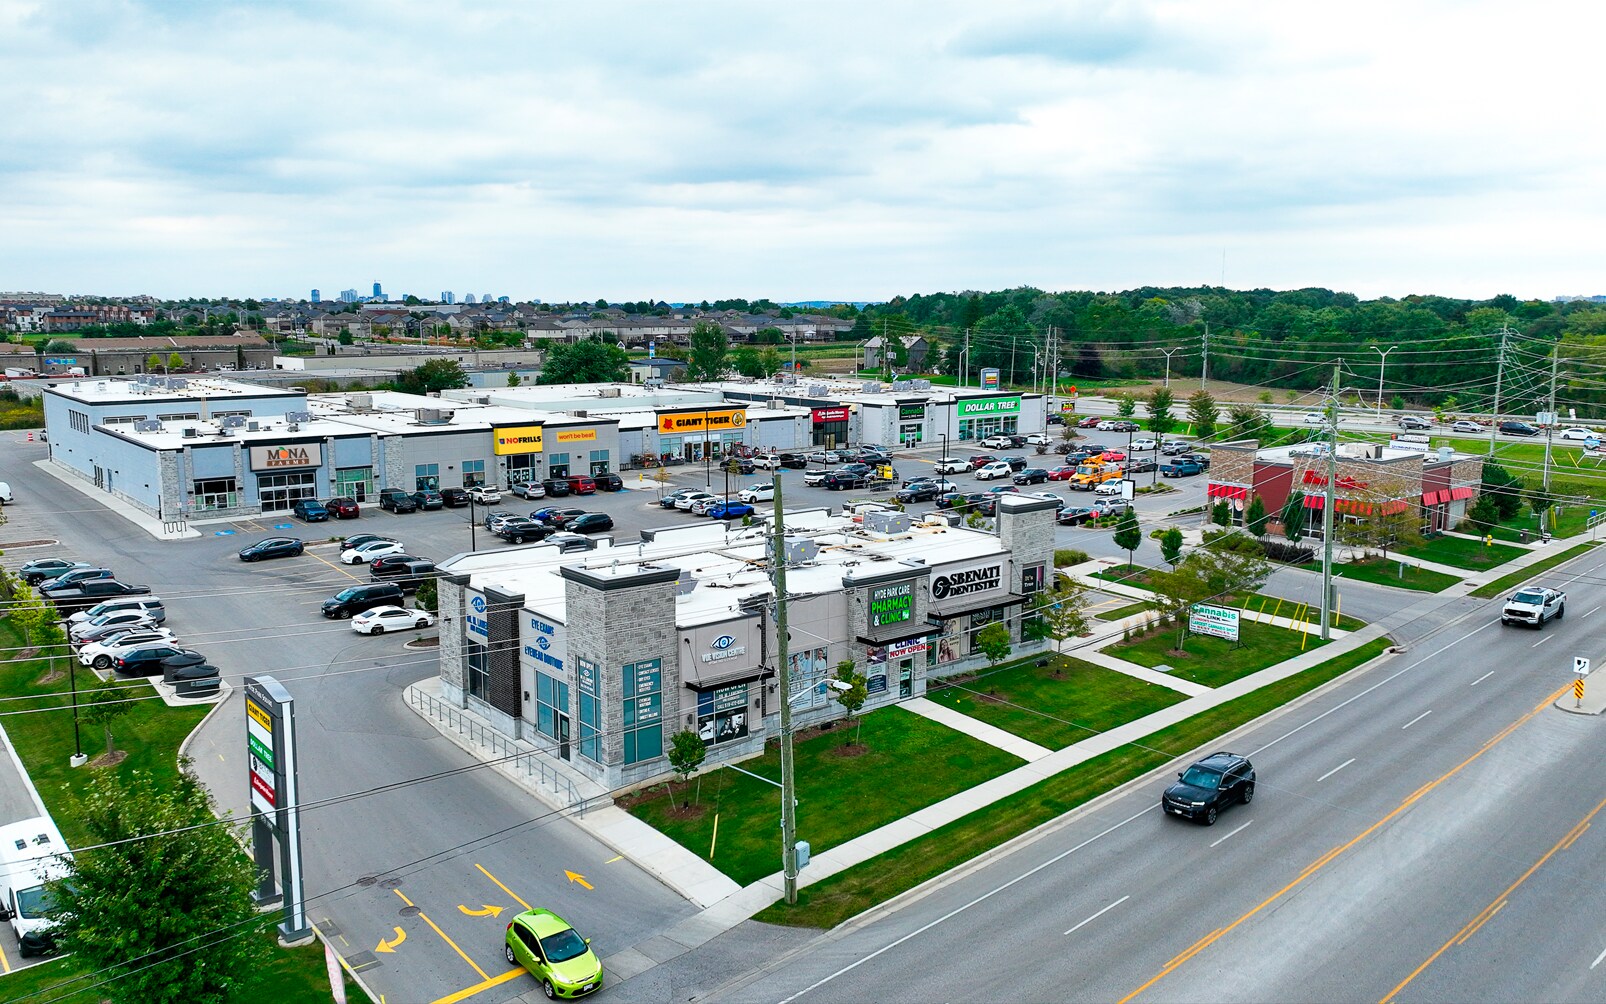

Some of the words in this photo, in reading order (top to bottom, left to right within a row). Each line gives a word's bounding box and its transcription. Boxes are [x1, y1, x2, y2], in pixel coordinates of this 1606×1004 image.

[901, 407, 924, 415] Cannabis
[965, 403, 995, 412] DOLLAR
[997, 401, 1016, 410] TREE
[676, 418, 703, 427] GIANT
[705, 416, 730, 425] TIGER
[949, 564, 1001, 586] SBENATI
[874, 589, 887, 600] HYDE
[887, 586, 898, 597] PARK
[898, 584, 910, 595] CARE
[949, 579, 1000, 597] DENTISTRY
[871, 594, 913, 615] PHARMACY
[1191, 603, 1237, 620] Cannabis
[873, 615, 880, 627] &
[880, 611, 902, 625] CLINIC
[531, 618, 540, 631] EYE
[540, 622, 555, 637] EXAMS
[889, 649, 906, 658] NOW
[907, 643, 926, 653] OPEN
[895, 638, 920, 649] CLINIC
[524, 644, 544, 662] EYEWEAR
[711, 649, 728, 661] VISION
[248, 703, 260, 717] GIANT
[259, 712, 271, 727] TIGER
[249, 738, 263, 755] DOLLAR
[263, 749, 273, 763] TREE
